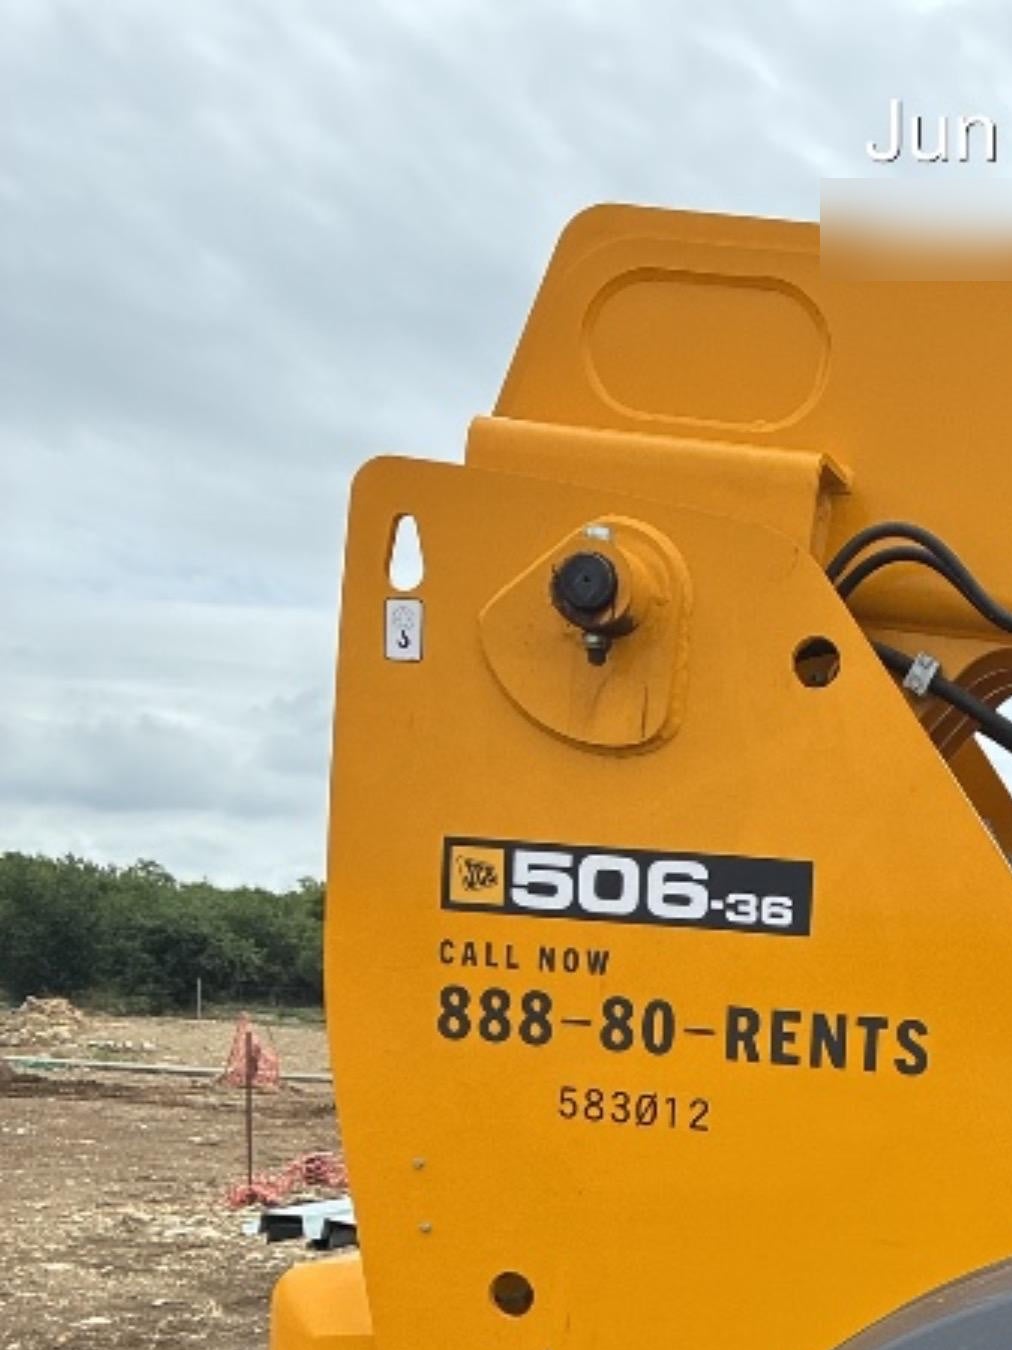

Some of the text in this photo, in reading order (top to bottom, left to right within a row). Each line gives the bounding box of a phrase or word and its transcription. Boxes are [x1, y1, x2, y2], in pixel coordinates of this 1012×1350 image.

[509, 849, 794, 927] 506-36
[439, 938, 611, 976] CALL NOW
[437, 984, 930, 1077] 888-80-RENTS
